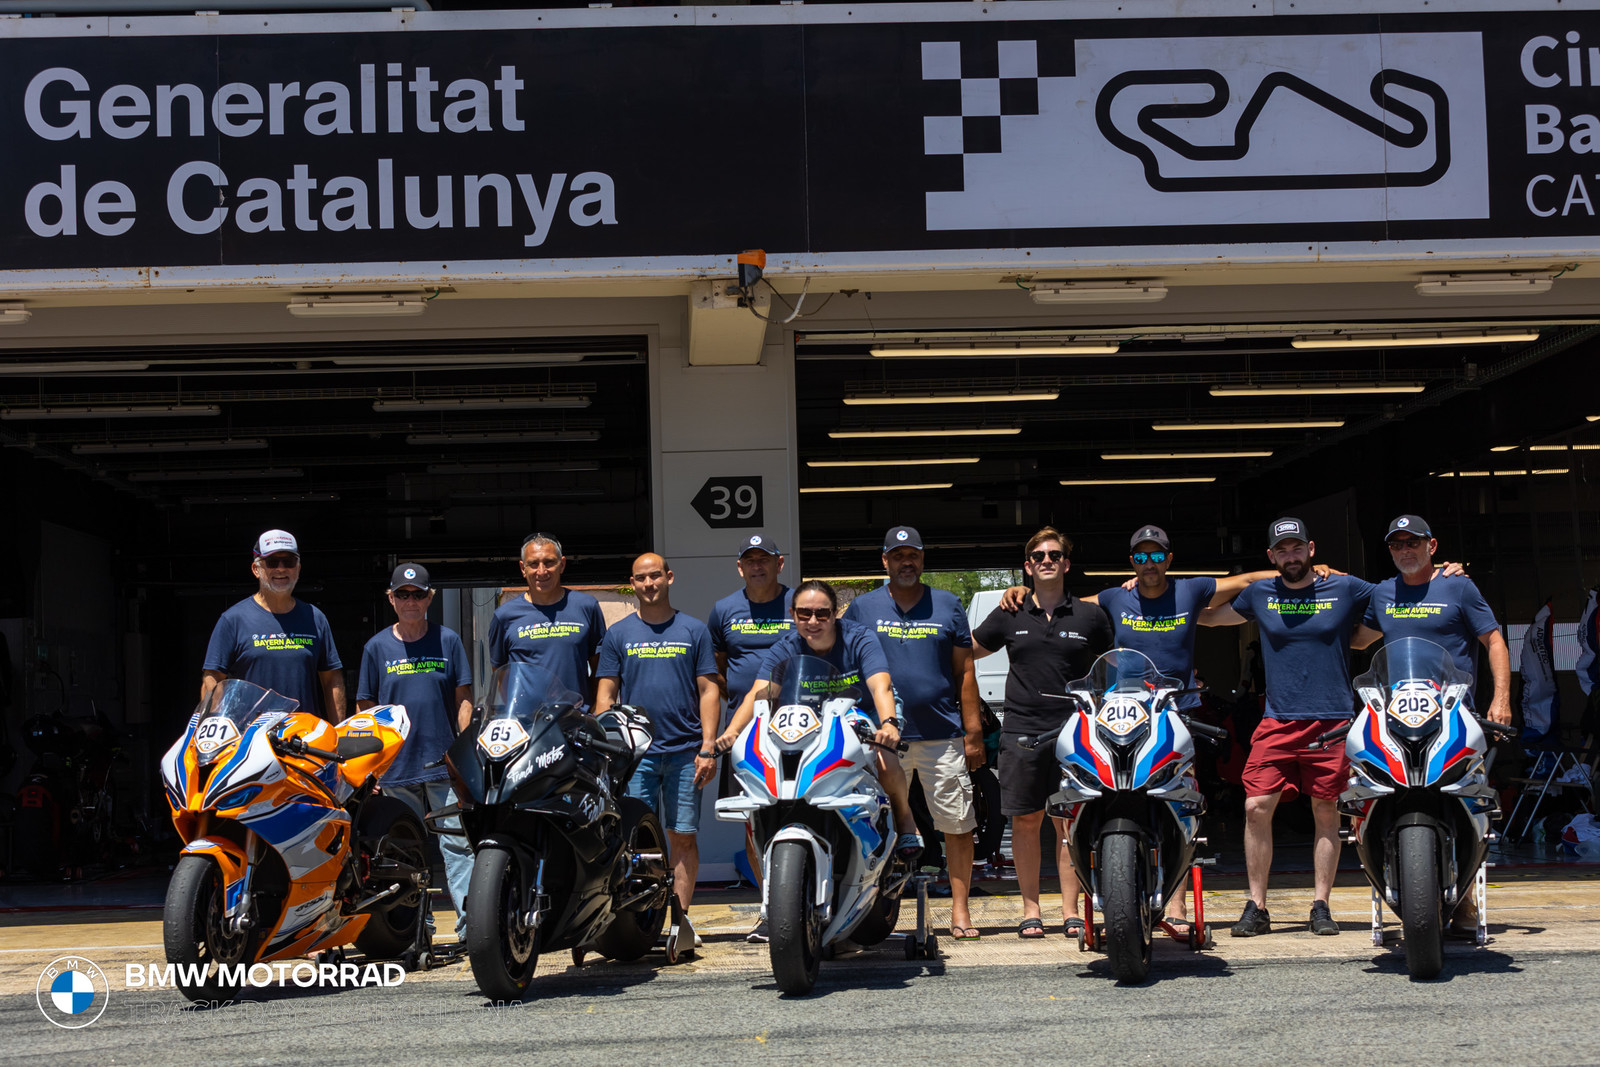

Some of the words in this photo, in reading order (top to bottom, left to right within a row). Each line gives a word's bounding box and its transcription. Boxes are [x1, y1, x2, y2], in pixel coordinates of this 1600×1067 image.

[23, 62, 526, 140] Generalitat
[23, 163, 137, 238] de
[166, 157, 619, 247] Catalunya
[1526, 174, 1600, 218] CA
[710, 485, 758, 520] 39
[1267, 602, 1297, 610] BAYERN
[1299, 602, 1332, 610] AVENUE
[1410, 606, 1441, 614] AVENUE
[761, 622, 790, 630] AVENUE
[1122, 617, 1153, 627] BAYERN
[1154, 616, 1186, 627] AVENUE
[519, 626, 549, 639] BAYERN
[550, 625, 580, 633] AVENUE
[908, 627, 938, 635] AVENUE
[254, 638, 285, 647] BAYERN
[285, 638, 313, 646] AVENUE
[627, 646, 657, 656] BAYERN
[658, 646, 687, 654] AVENUE
[387, 663, 415, 674] BAYERN
[417, 660, 445, 668] AVENUE
[1398, 697, 1430, 714] 202
[1107, 706, 1138, 722] 204
[199, 723, 229, 740] 201
[490, 726, 512, 742] 65
